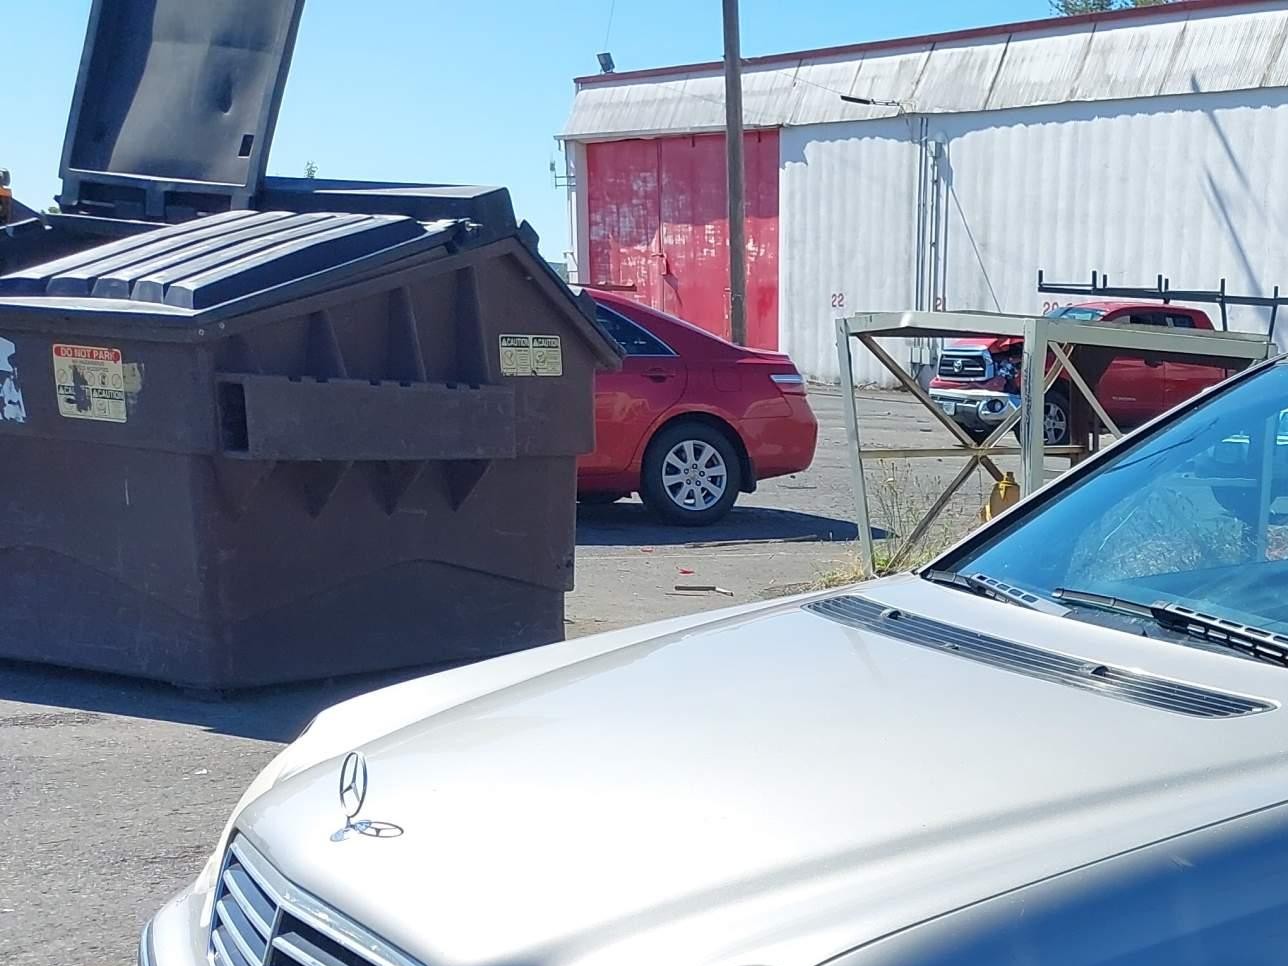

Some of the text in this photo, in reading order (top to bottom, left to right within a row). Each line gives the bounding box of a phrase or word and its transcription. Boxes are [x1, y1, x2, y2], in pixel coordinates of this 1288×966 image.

[831, 293, 845, 307] 22
[60, 347, 73, 357] DO
[74, 348, 91, 358] NOT
